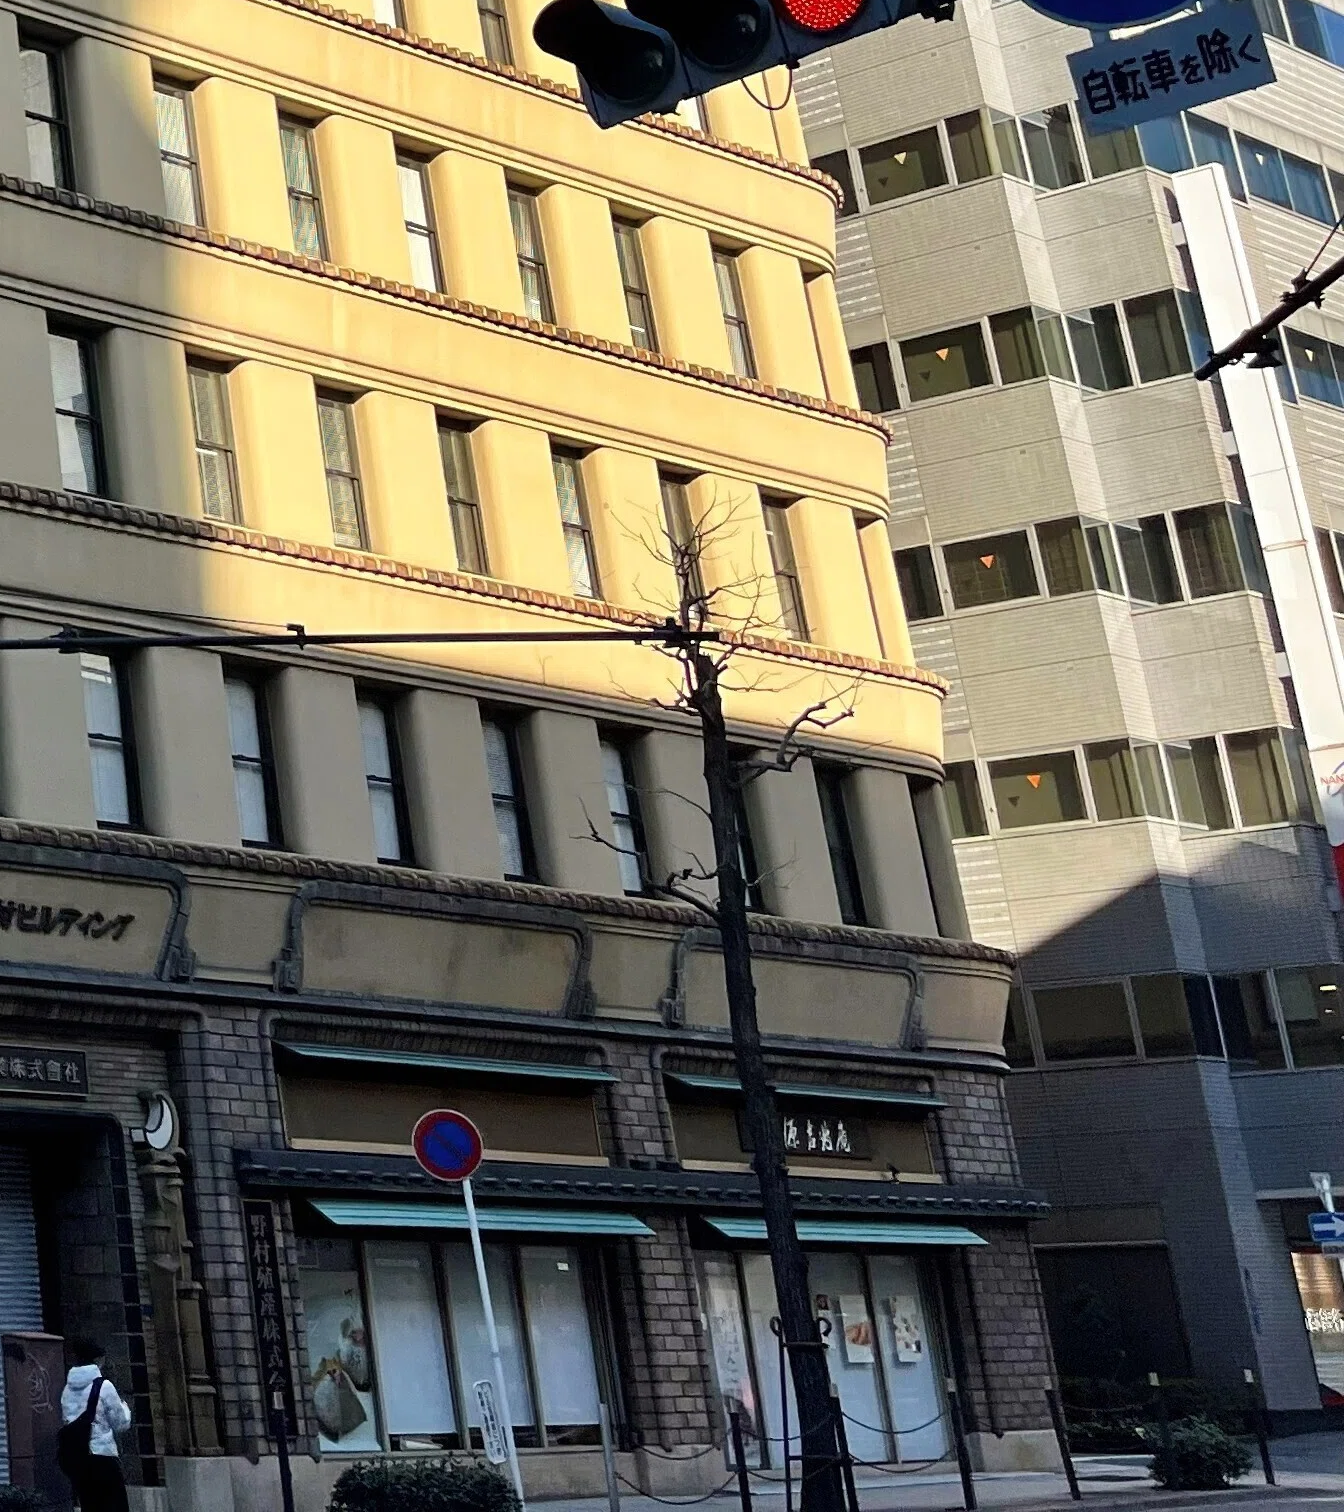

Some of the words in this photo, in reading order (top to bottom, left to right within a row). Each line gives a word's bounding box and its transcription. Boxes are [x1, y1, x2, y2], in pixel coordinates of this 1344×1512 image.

[1081, 27, 1262, 115] 自転車を除く
